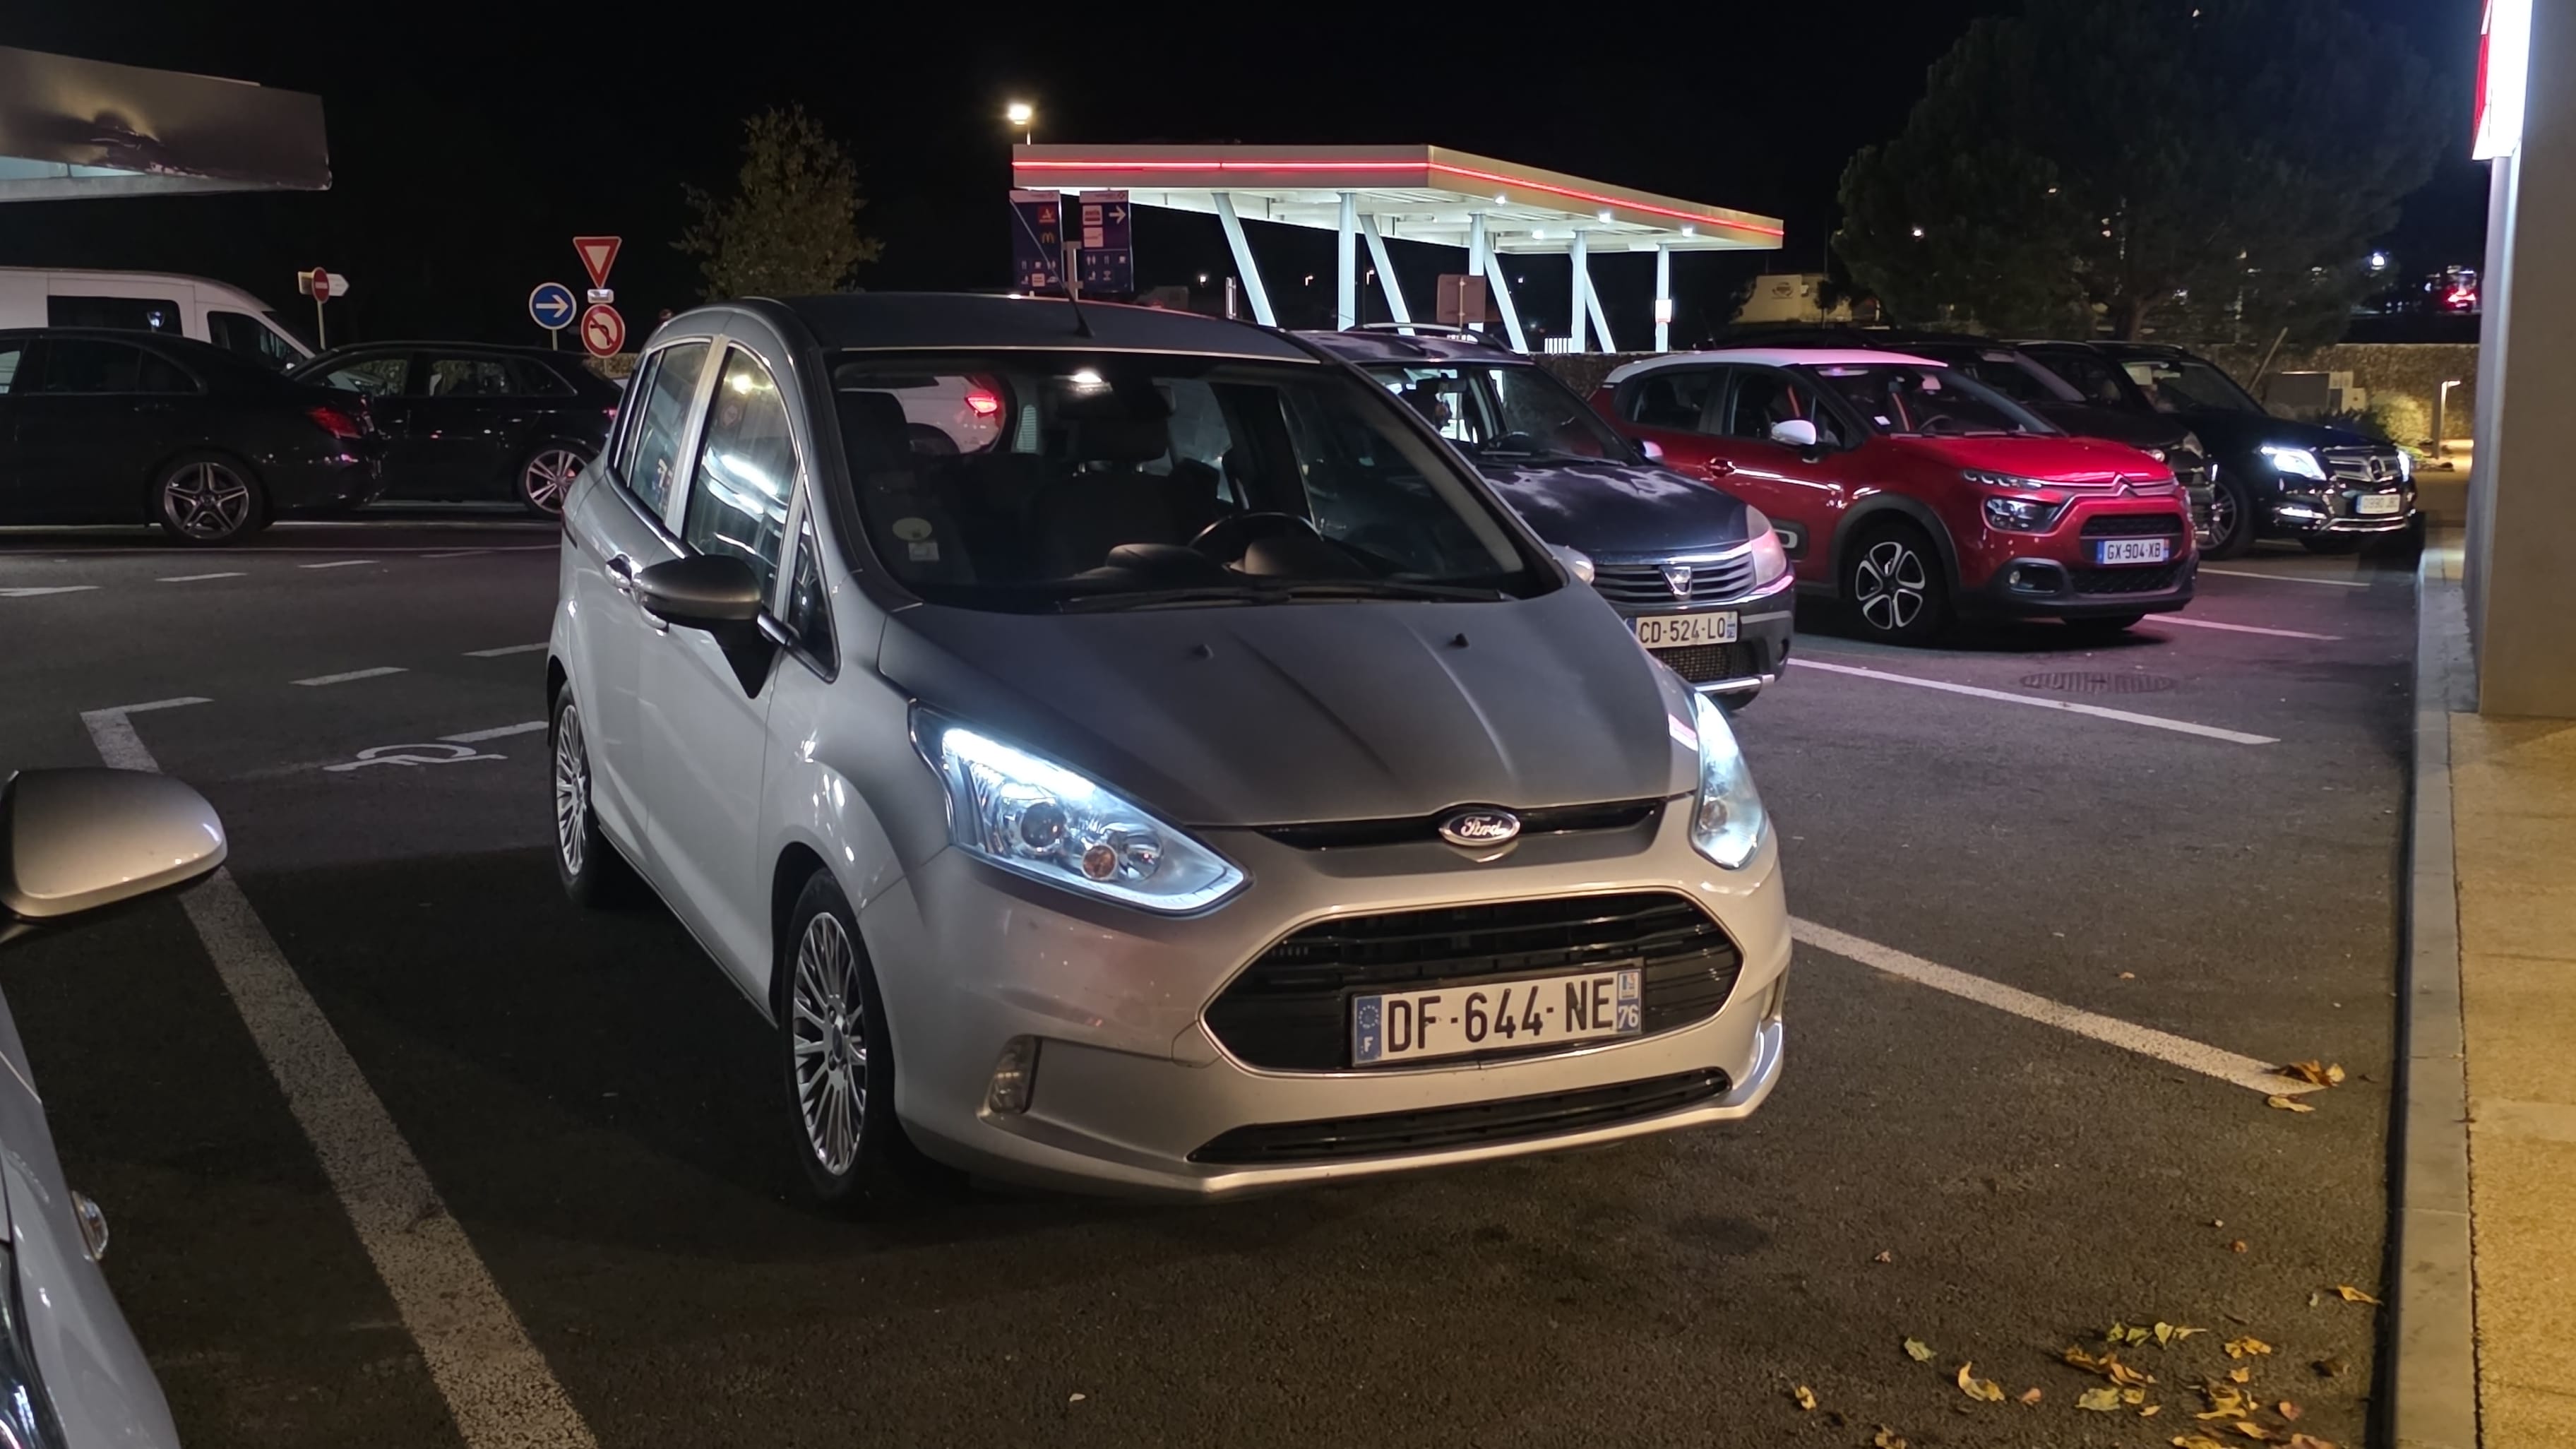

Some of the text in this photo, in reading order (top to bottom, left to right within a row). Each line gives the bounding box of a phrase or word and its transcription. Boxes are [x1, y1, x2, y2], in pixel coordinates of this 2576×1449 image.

[2107, 542, 2161, 559] GX-904-XB
[1460, 816, 1508, 837] Ford
[1364, 977, 1614, 1052] F DF-644-NE
[1618, 1004, 1638, 1029] 76
